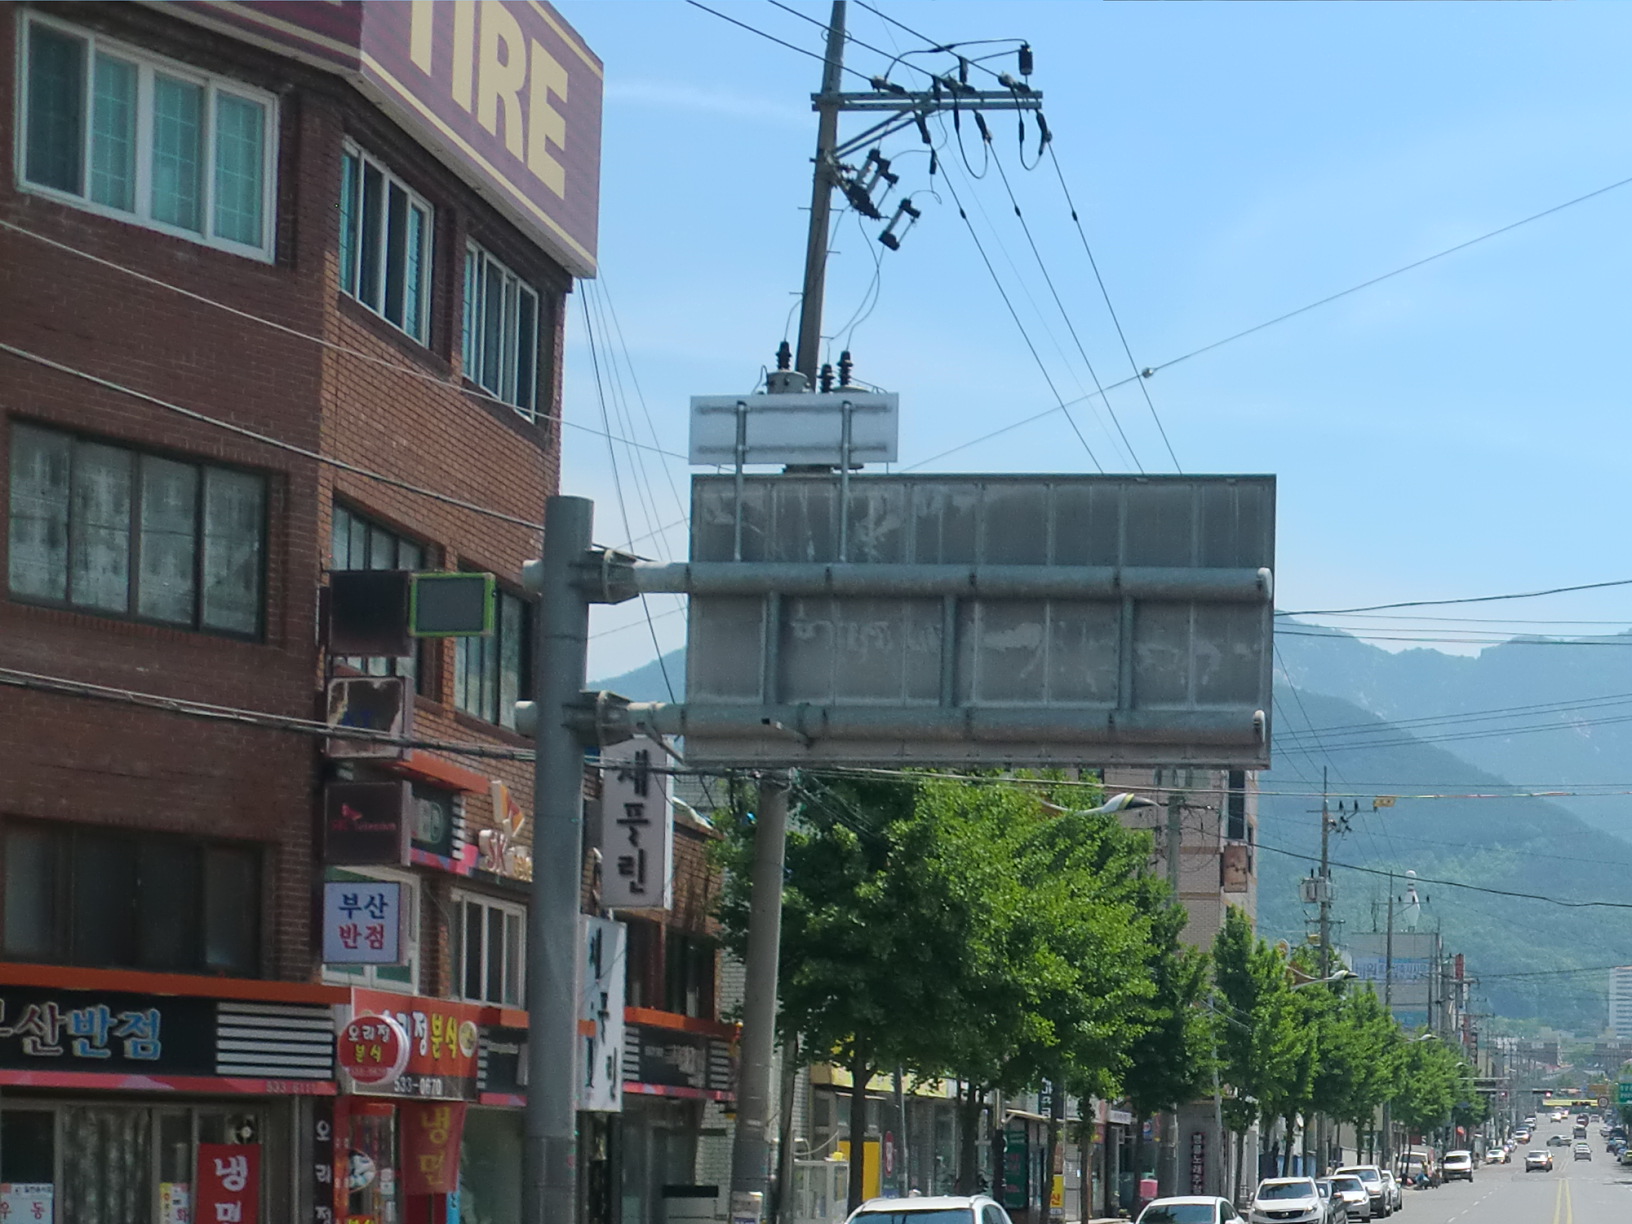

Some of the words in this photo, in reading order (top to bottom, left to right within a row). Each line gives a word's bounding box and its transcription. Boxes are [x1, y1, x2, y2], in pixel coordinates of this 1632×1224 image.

[338, 893, 388, 920] 부산
[339, 924, 385, 950] 반점
[349, 1023, 391, 1043] 오리정
[355, 1044, 382, 1063] 분식
[421, 1105, 452, 1186] 냉면
